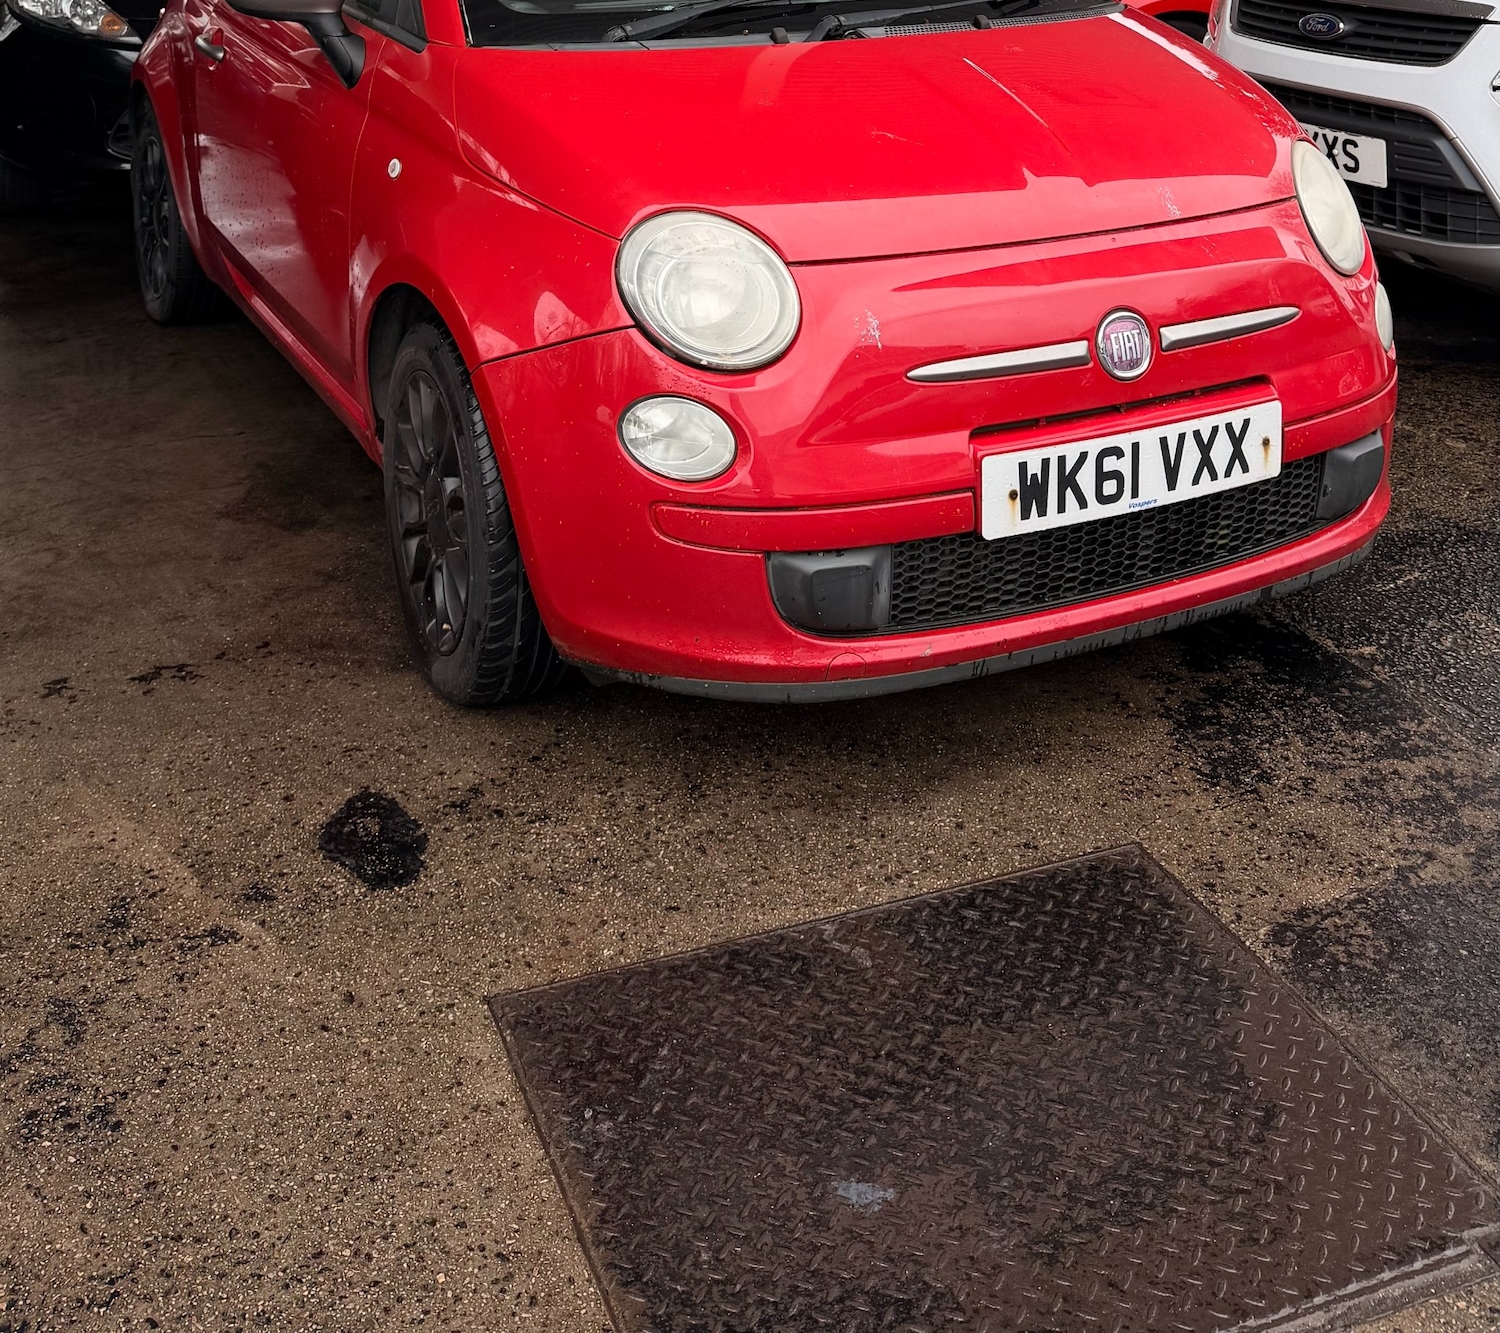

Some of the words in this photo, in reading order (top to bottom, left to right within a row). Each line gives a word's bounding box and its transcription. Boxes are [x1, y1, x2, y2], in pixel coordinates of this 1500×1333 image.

[1306, 17, 1330, 32] Ford
[1305, 129, 1360, 174] XS
[1110, 329, 1141, 362] FIAT
[1018, 441, 1140, 521] WK61
[1159, 417, 1251, 492] VXX
[1128, 498, 1158, 509] Vospers
